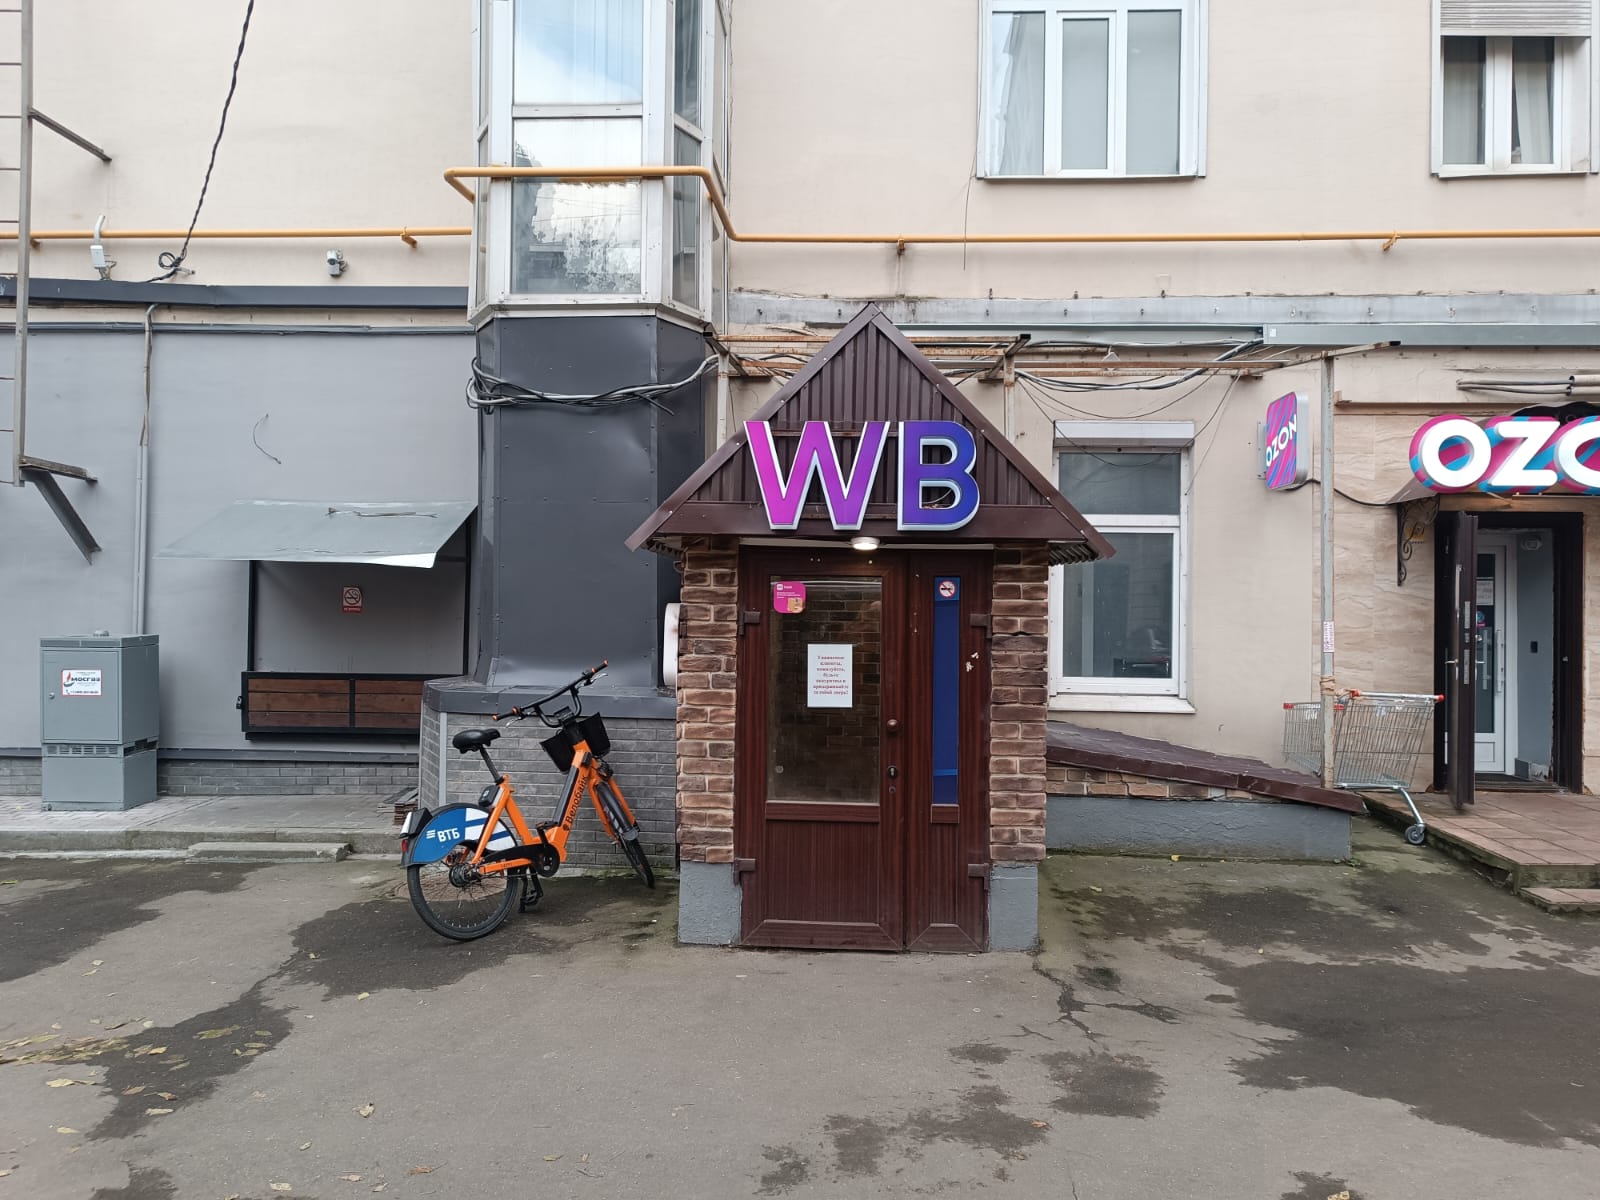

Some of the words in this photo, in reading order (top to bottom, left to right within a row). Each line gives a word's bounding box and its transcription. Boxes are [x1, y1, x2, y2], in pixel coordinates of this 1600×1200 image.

[1266, 413, 1297, 467] OZON
[743, 420, 980, 530] WB
[565, 775, 588, 824] Велобайк
[437, 827, 461, 842] ВТБ
